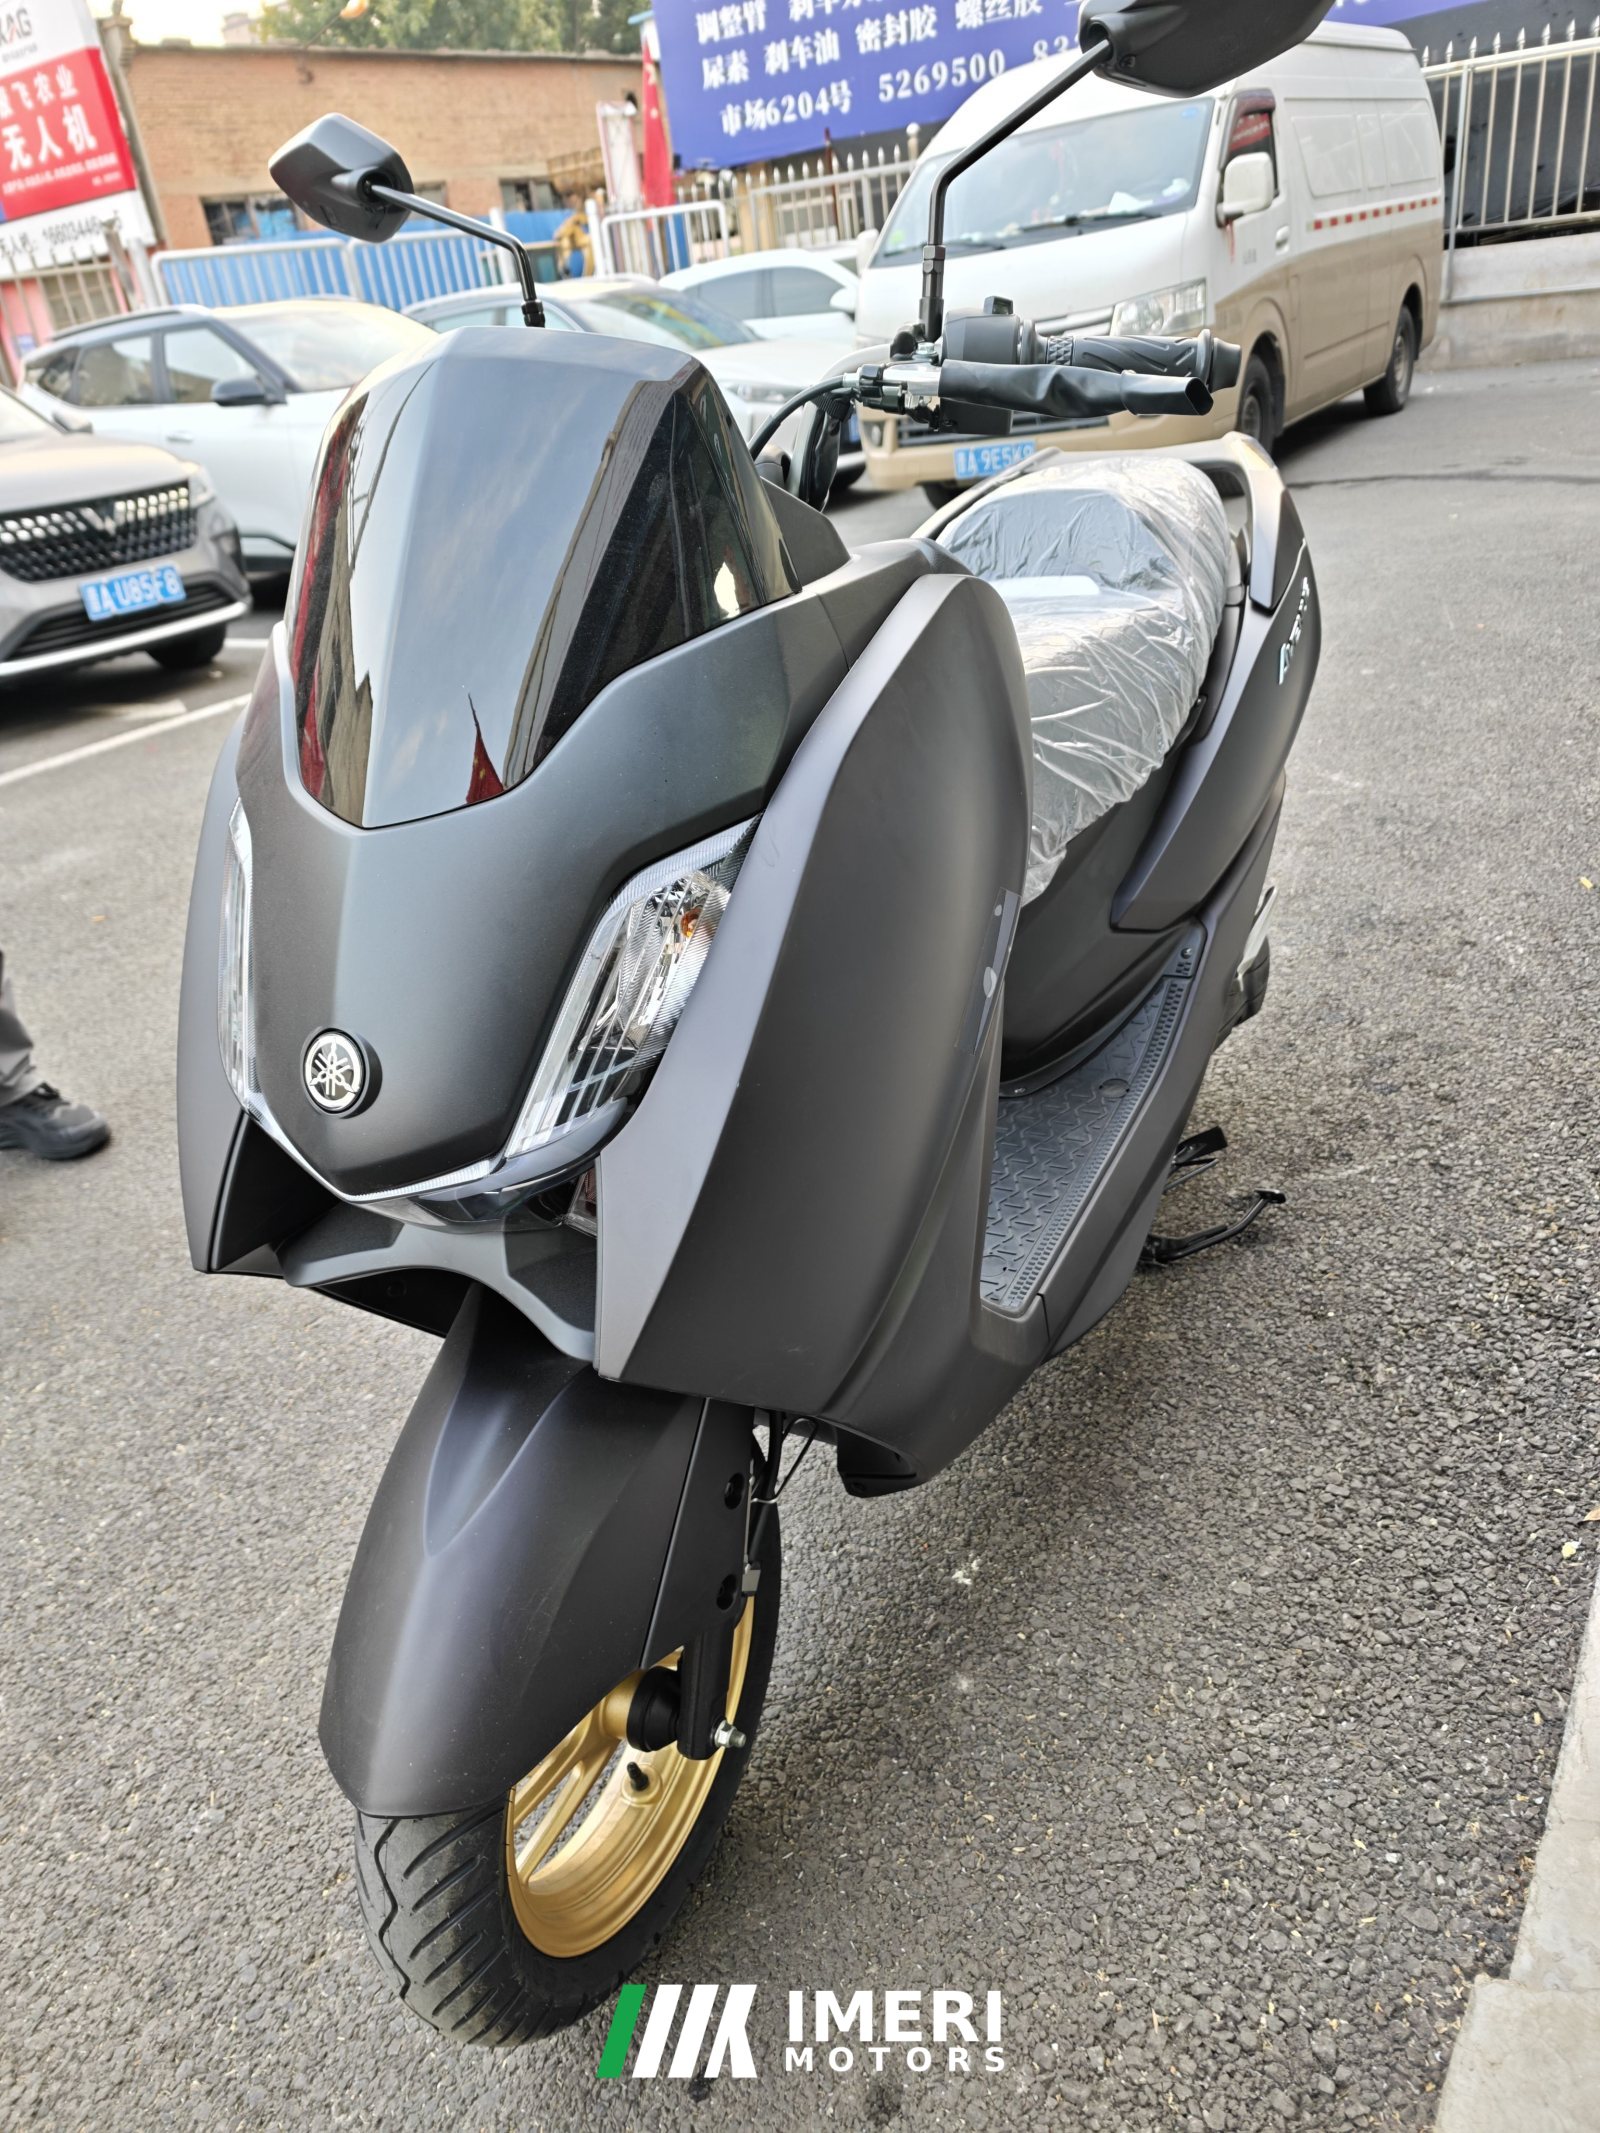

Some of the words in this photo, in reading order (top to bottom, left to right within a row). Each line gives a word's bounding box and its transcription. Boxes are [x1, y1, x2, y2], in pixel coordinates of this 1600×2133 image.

[702, 49, 750, 91] 尿素
[764, 27, 840, 76] 刹车油
[855, 5, 938, 54] 密封胶
[720, 79, 853, 137] 市场6204号
[879, 48, 1006, 103] 5269500
[1, 104, 98, 173] 无人机
